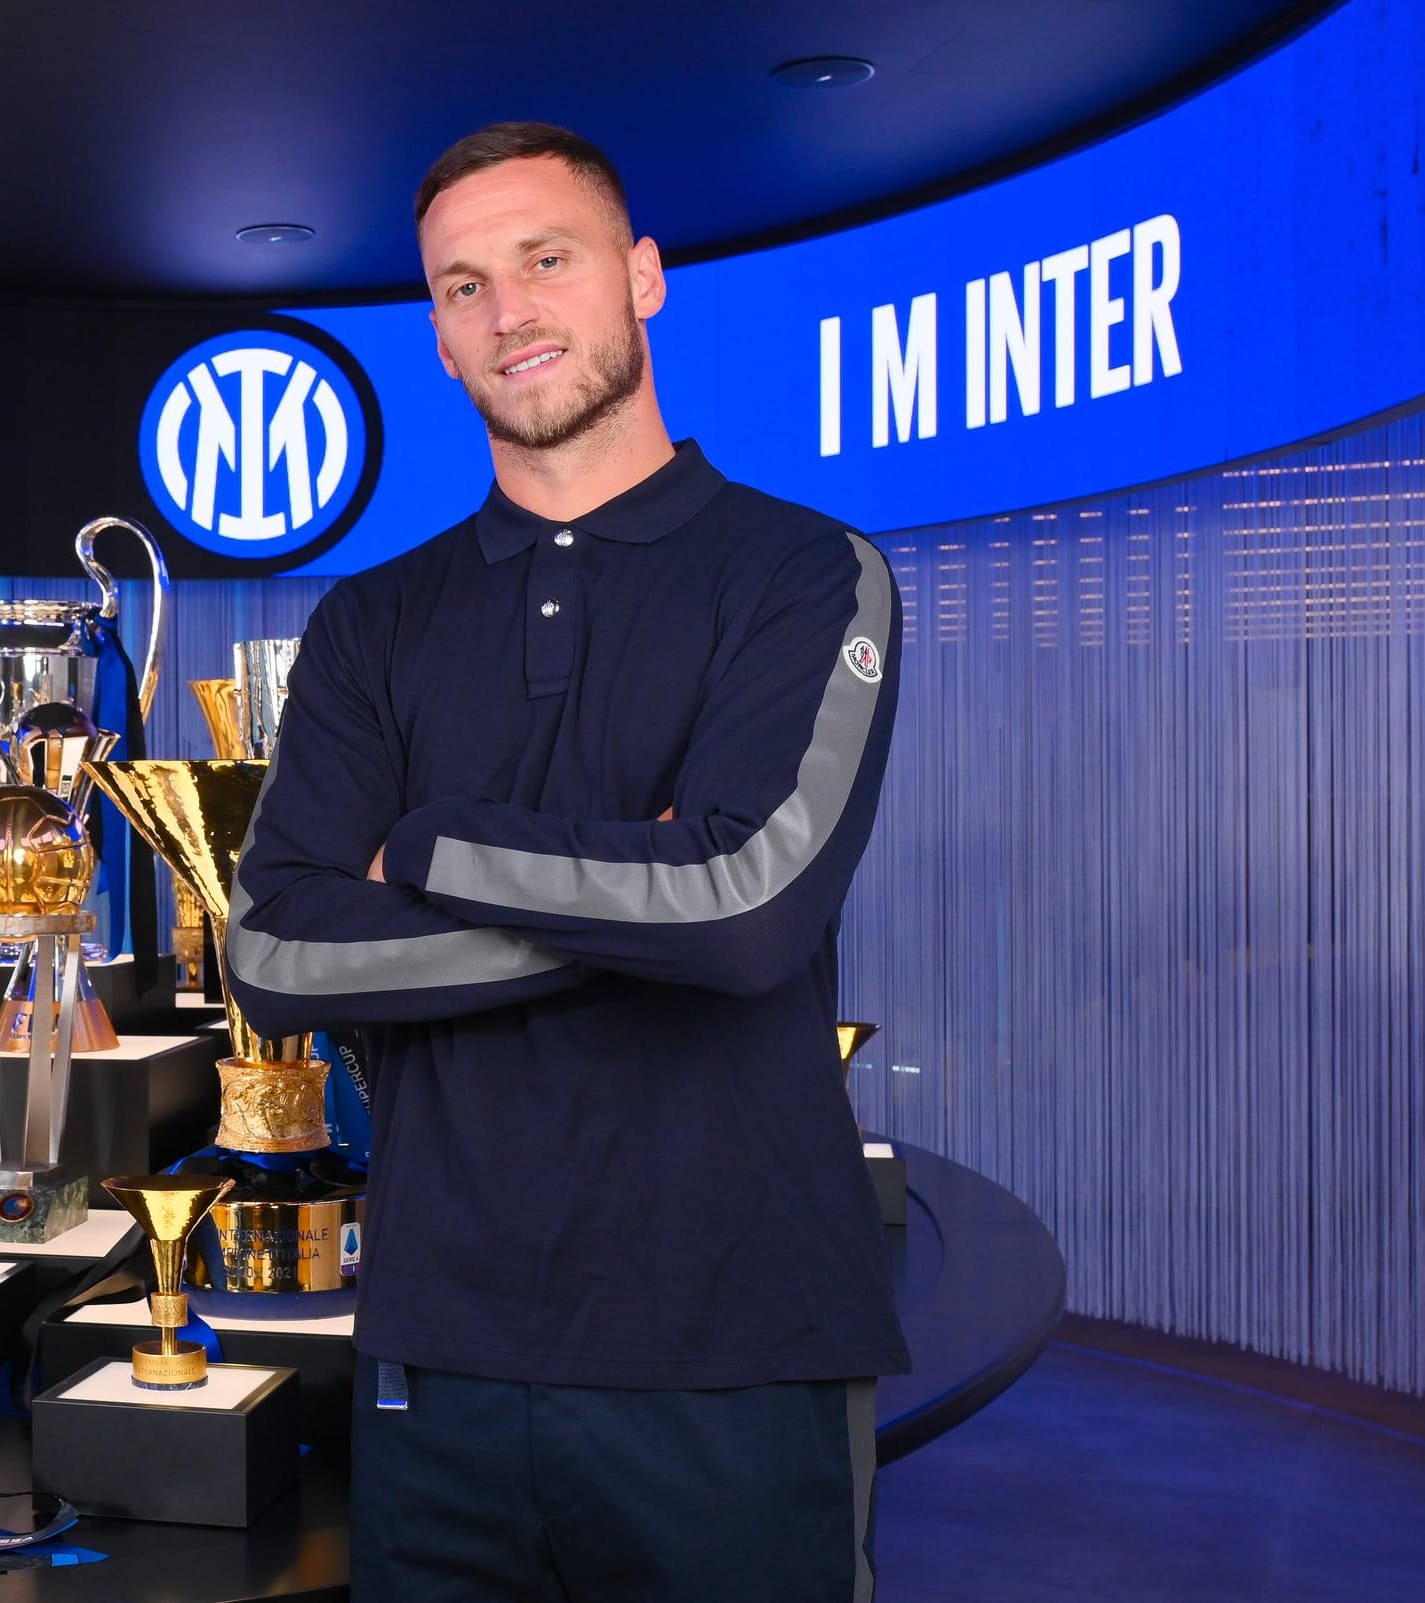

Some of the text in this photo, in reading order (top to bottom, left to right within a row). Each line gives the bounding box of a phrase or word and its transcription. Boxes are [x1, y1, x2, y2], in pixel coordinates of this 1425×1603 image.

[820, 214, 1183, 457] I M INTER
